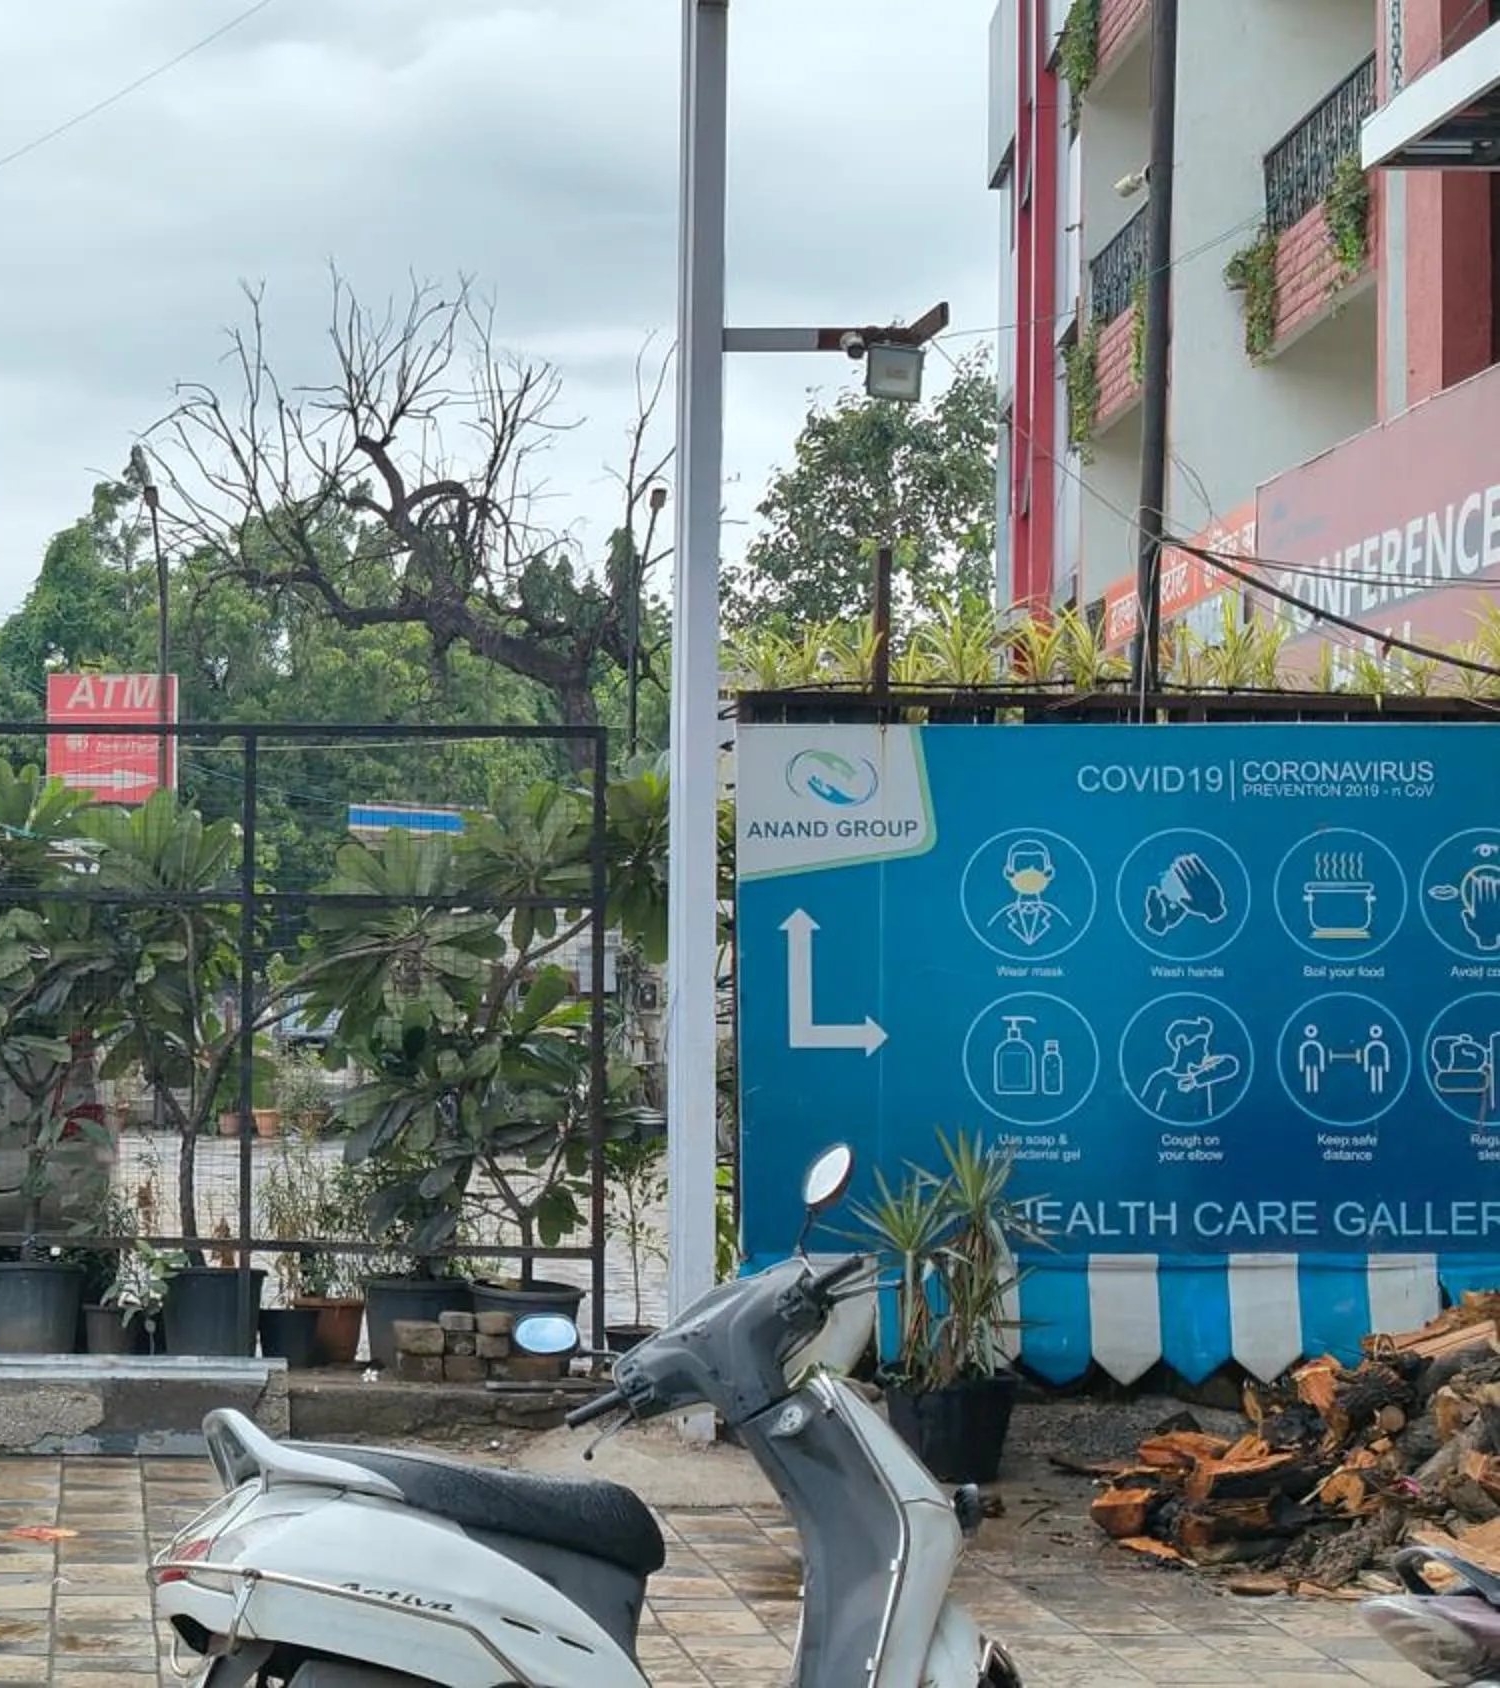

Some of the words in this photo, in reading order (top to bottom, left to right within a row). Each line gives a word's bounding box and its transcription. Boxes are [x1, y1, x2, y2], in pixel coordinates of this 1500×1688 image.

[67, 674, 160, 709] ATM
[1077, 765, 1223, 793] COVID19
[1243, 761, 1435, 783] CORONAVIRUS
[1243, 783, 1341, 797] PREVENTION
[1345, 783, 1380, 797] 2019
[1404, 784, 1435, 797] CoV
[747, 820, 830, 838] ANAND
[835, 819, 918, 838] GROUP
[996, 965, 1029, 977] Wear
[1031, 965, 1064, 977] mask
[1151, 965, 1187, 978] Wash
[1189, 965, 1225, 978] hands
[1303, 965, 1327, 977] Boil
[1329, 967, 1356, 981] your
[1358, 965, 1385, 977] food
[1450, 965, 1483, 978] Avoid
[1025, 1135, 1056, 1149] soap
[1161, 1133, 1203, 1149] Cough
[1205, 1136, 1221, 1146] on
[1317, 1133, 1350, 1149] Keep
[1351, 1134, 1379, 1147] safe
[1062, 1148, 1081, 1164] gel
[1158, 1151, 1185, 1164] your
[1187, 1149, 1224, 1161] elbow
[1323, 1149, 1373, 1161] distance
[1192, 1201, 1319, 1237] CARE
[338, 1581, 455, 1613] Activa
